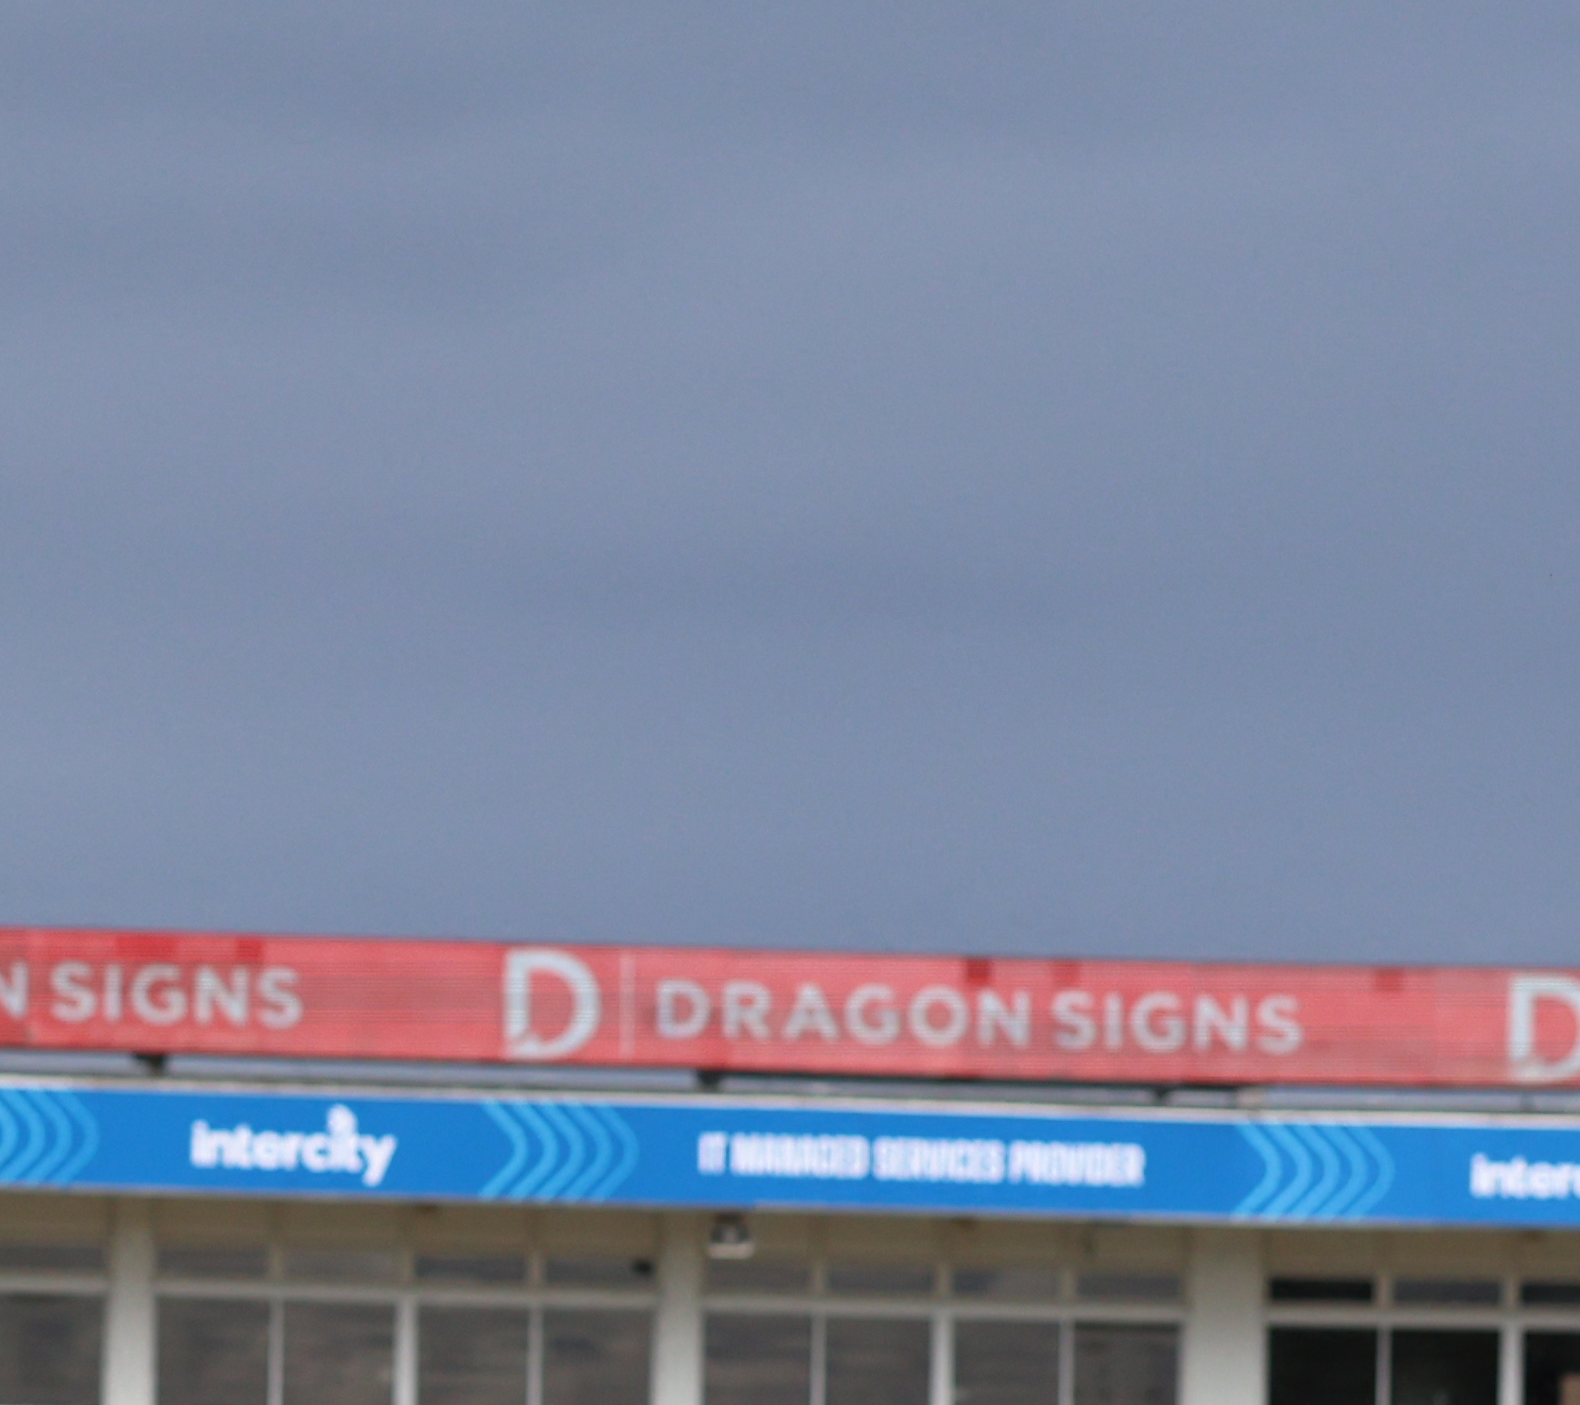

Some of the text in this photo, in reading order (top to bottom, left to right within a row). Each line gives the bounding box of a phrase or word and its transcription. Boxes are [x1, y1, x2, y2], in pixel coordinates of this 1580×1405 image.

[50, 960, 303, 1029] SIGNS
[504, 950, 1304, 1056] D DRAGON SIGNS
[729, 1133, 870, 1181] MANAGED
[872, 1136, 1006, 1185] SERVICES
[1007, 1139, 1146, 1188] PROVIDER
